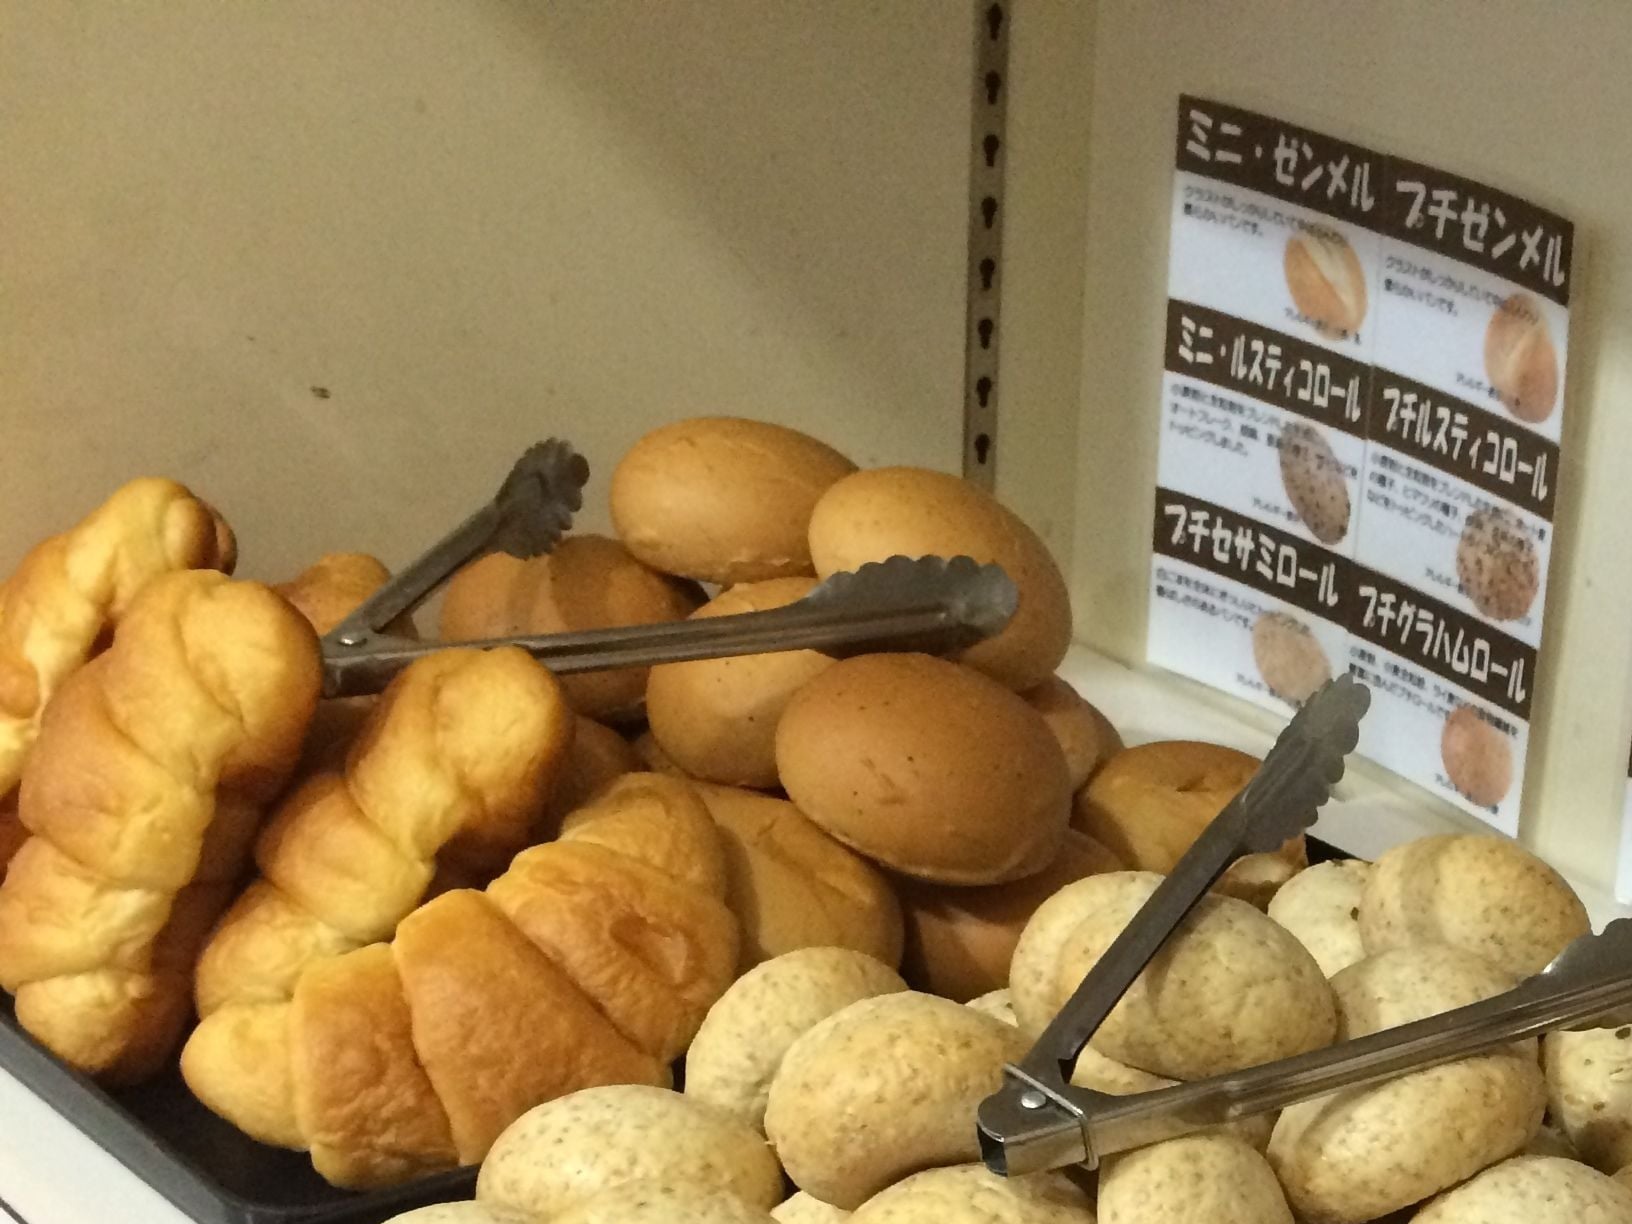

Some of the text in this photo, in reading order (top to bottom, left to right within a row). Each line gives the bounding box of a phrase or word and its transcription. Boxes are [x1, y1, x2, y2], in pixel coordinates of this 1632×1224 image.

[1186, 108, 1377, 213] ミニ・ゼンメル
[1393, 173, 1568, 288] プチゼンメル
[1178, 315, 1363, 424] ミニ・ルスティコロール
[1380, 383, 1550, 503] プチルスティコロール
[1163, 497, 1340, 609] プチセサミロール
[1356, 581, 1528, 705] プチグラハムロール
